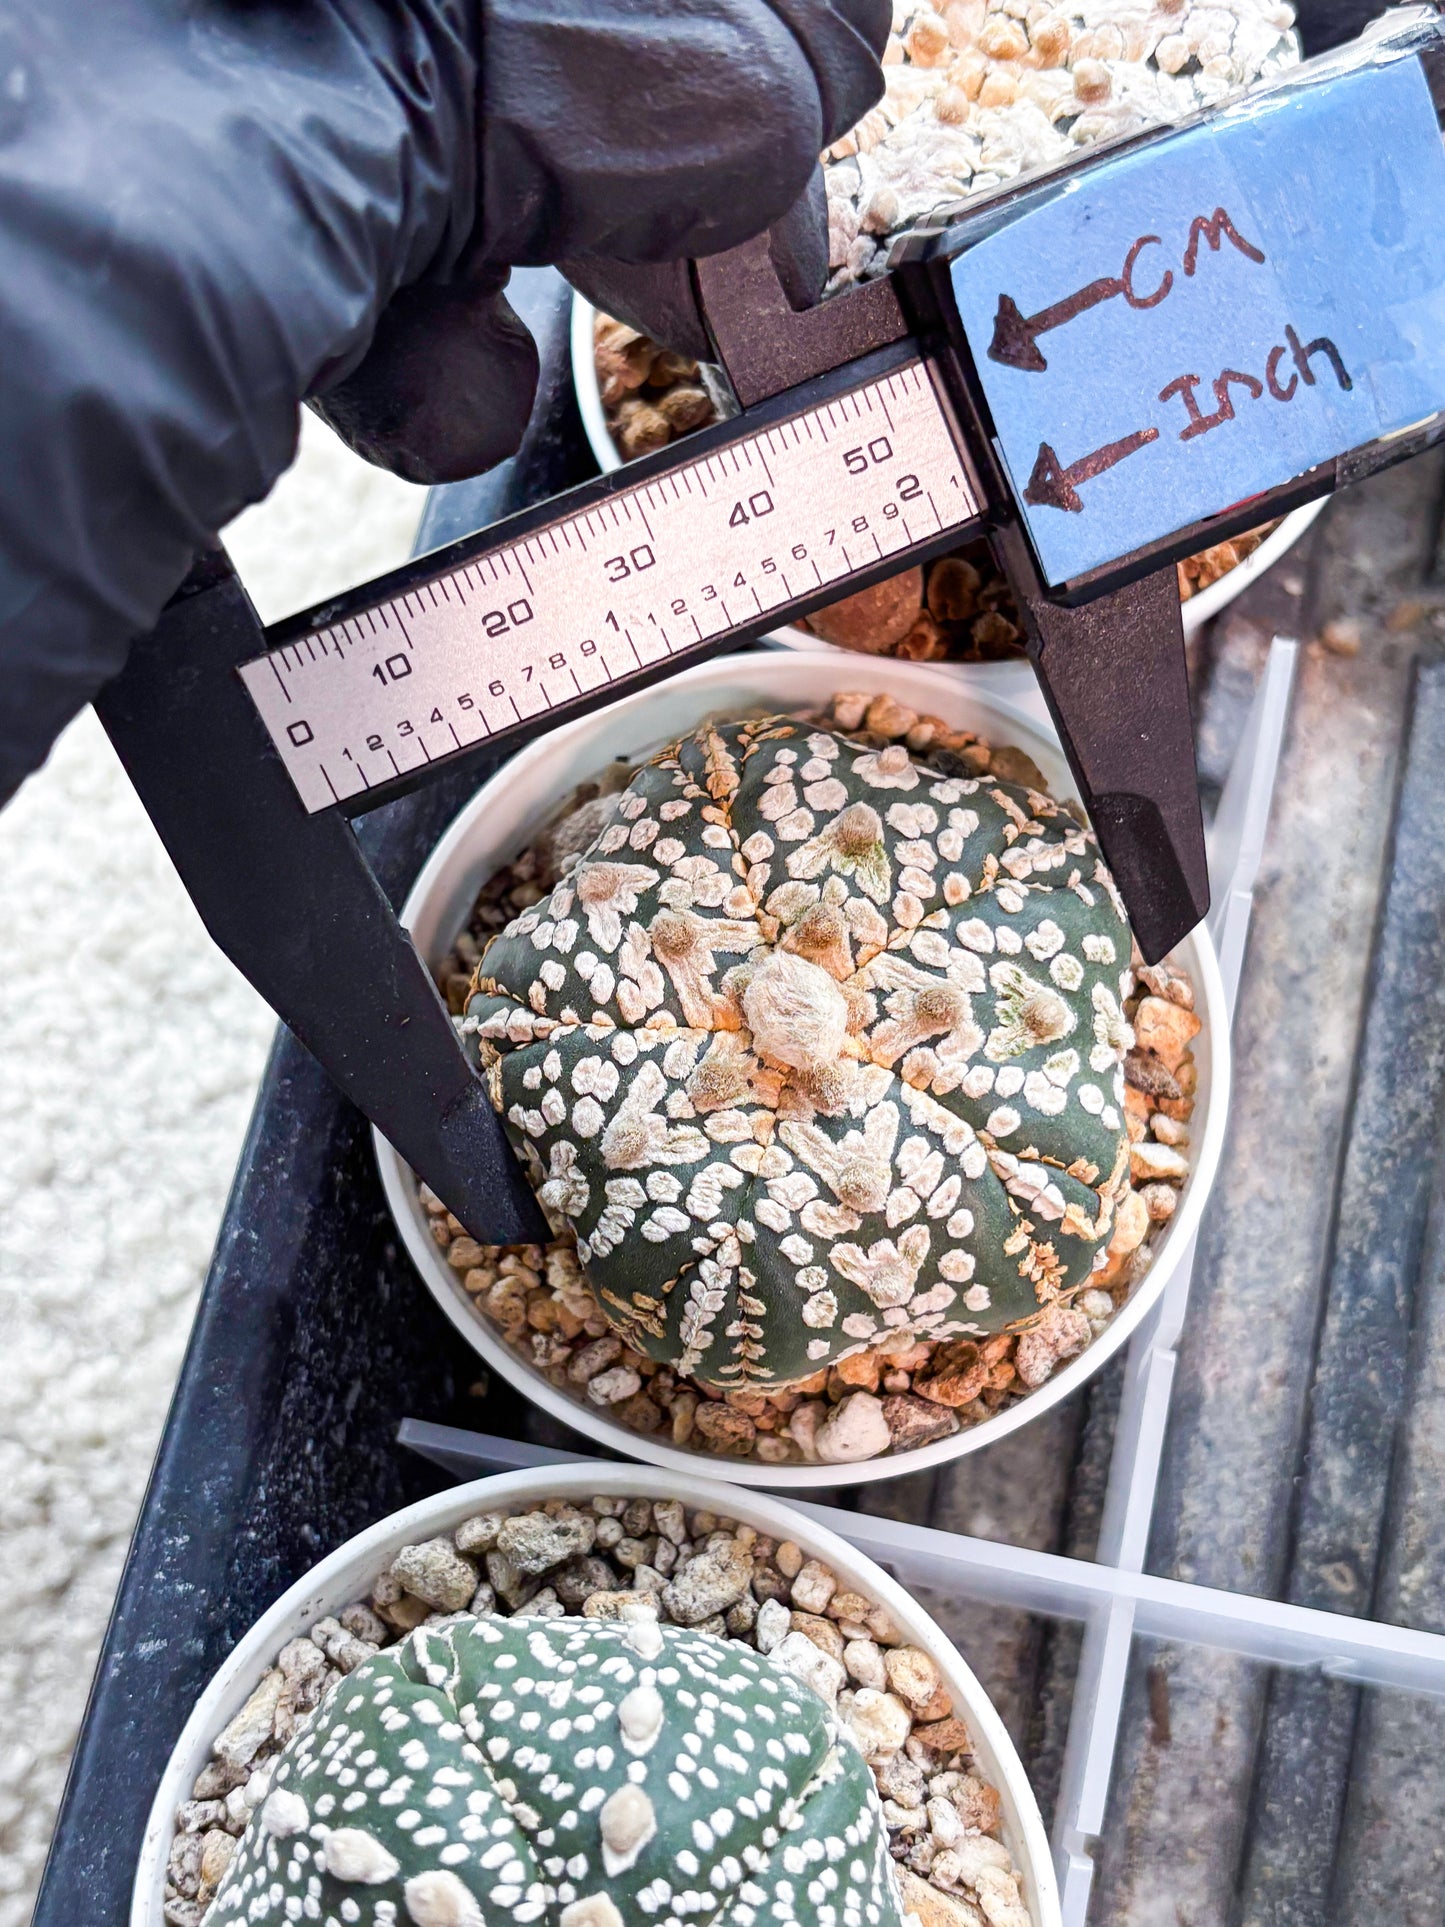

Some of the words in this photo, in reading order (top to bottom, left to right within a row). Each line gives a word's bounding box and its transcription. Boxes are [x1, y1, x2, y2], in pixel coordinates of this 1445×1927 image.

[1122, 207, 1266, 310] CM
[1158, 324, 1353, 442] Inch
[285, 719, 315, 748] 0
[372, 652, 413, 687] 10
[481, 598, 534, 639] 20
[603, 544, 657, 583] 30
[728, 490, 775, 529] 40
[842, 436, 894, 476] 50
[342, 747, 353, 761] 1
[365, 734, 385, 752] 2
[396, 719, 415, 738] 3
[430, 707, 444, 724] 4
[456, 692, 475, 711] 5
[488, 679, 505, 698] 6
[520, 665, 533, 683] 7
[548, 652, 567, 671] 8
[579, 639, 597, 658] 9
[605, 609, 620, 633] 1
[647, 612, 657, 626] 1
[670, 598, 689, 616] 2
[700, 584, 718, 602] 3
[733, 571, 747, 588] 4
[760, 556, 777, 575] 5
[791, 543, 808, 561] 6
[823, 528, 836, 546] 7
[851, 515, 870, 534] 8
[882, 502, 900, 521] 9
[895, 473, 924, 502] 2
[949, 474, 959, 489] 1
